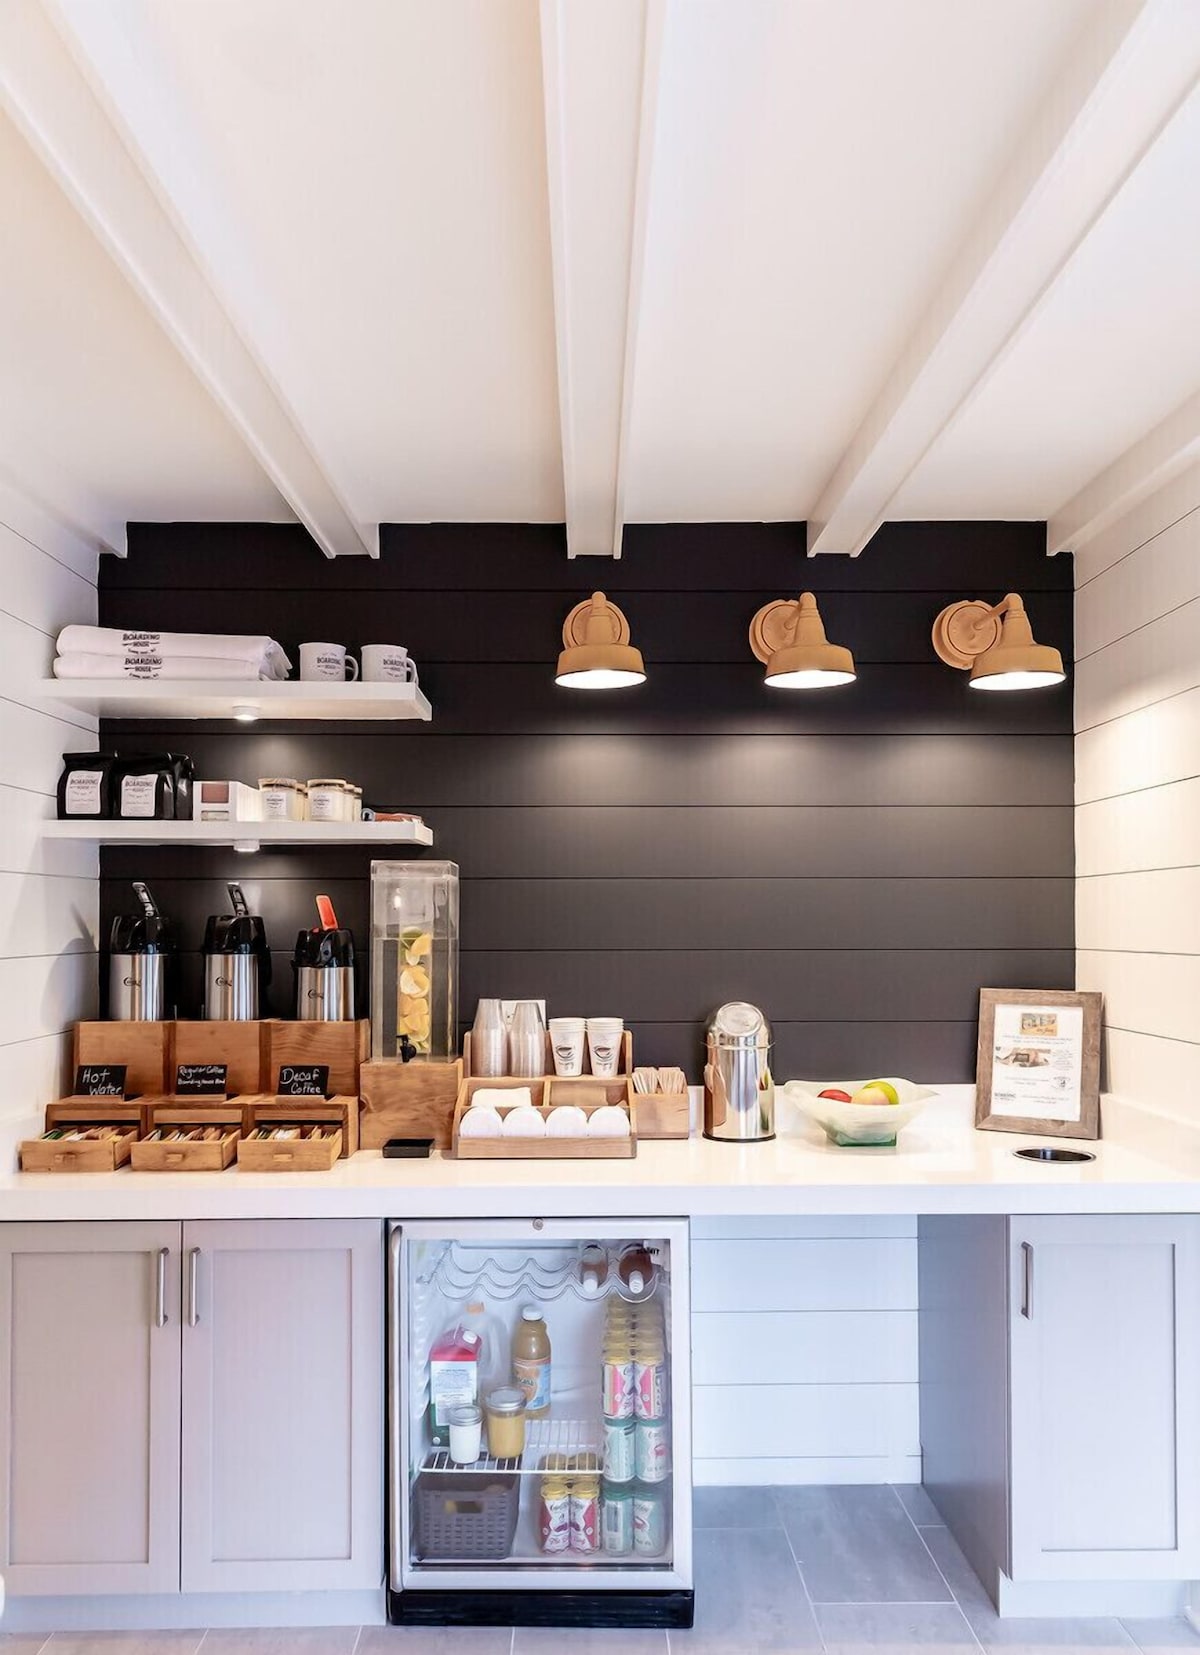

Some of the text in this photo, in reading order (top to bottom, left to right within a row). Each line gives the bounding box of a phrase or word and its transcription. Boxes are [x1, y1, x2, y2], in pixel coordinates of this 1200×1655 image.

[82, 1068, 111, 1083] Hot
[280, 1067, 320, 1085] Decaf
[89, 1083, 122, 1096] Water
[290, 1082, 321, 1095] Coffee
